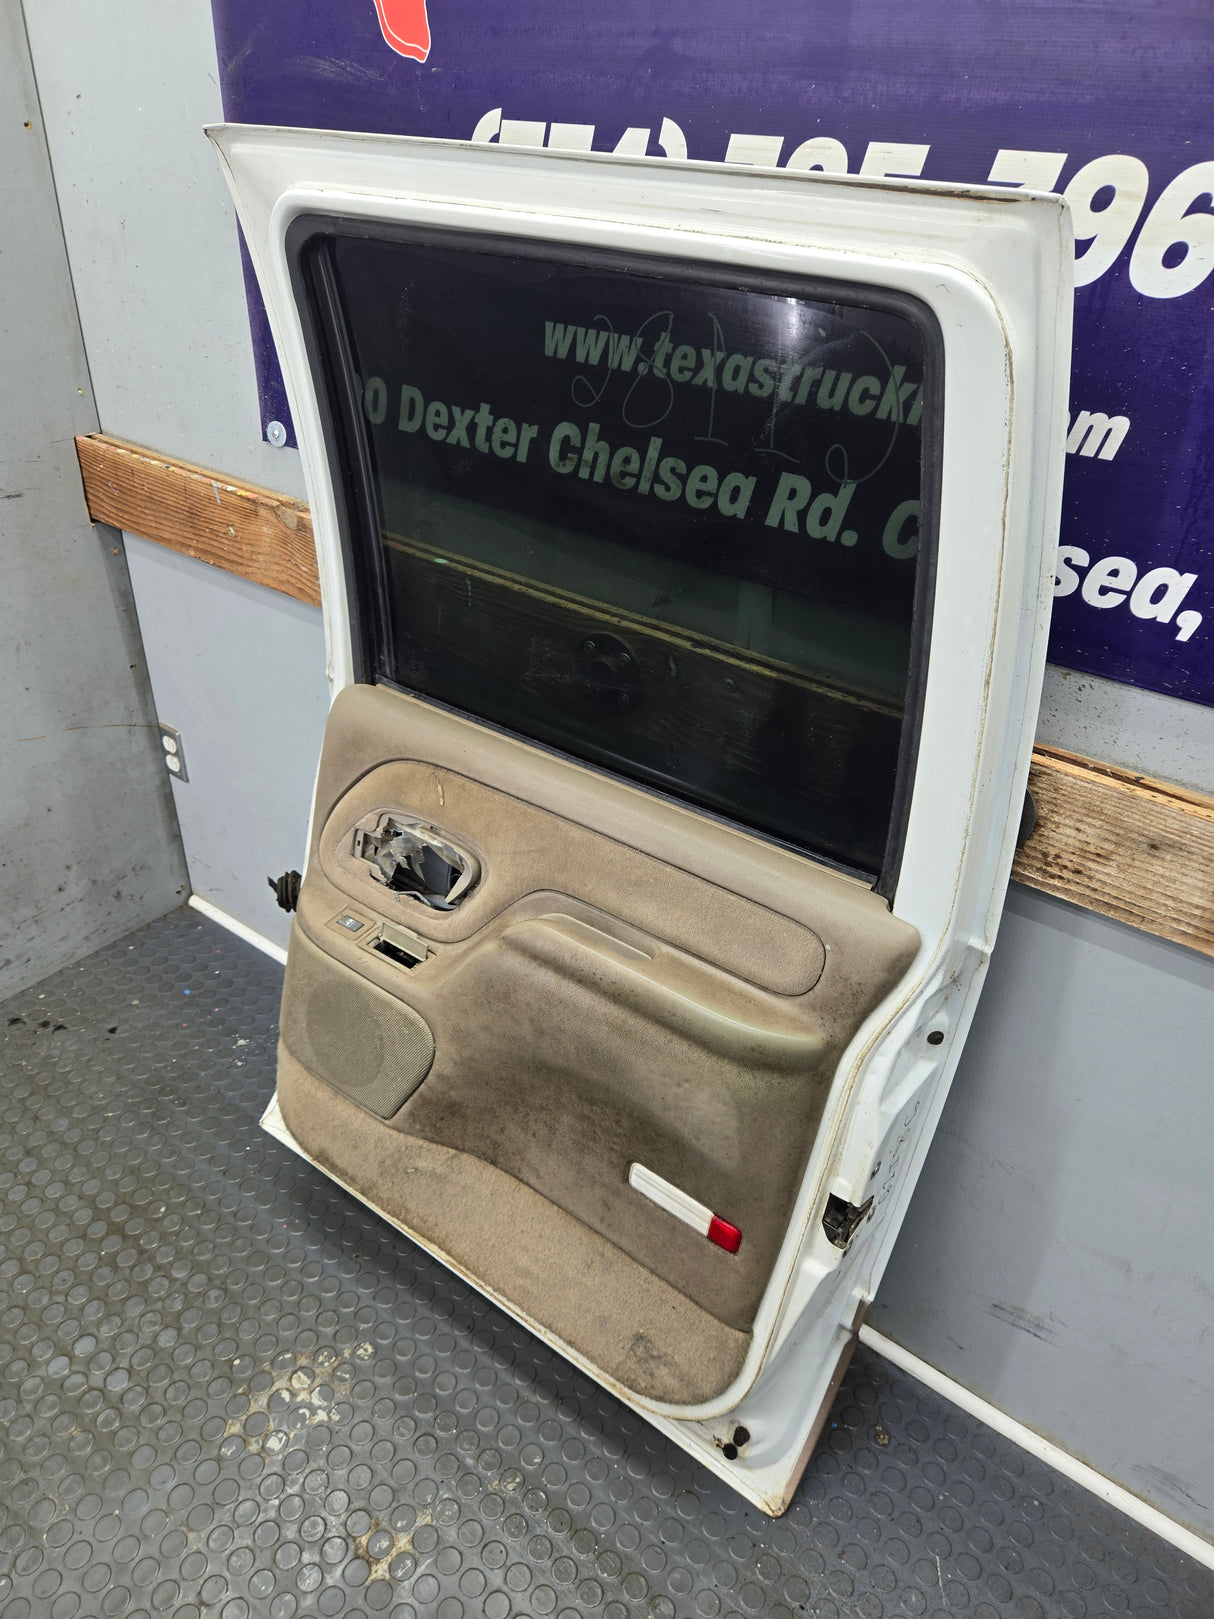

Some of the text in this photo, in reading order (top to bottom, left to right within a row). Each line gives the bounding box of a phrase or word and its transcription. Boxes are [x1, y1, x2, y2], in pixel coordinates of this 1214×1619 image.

[398, 384, 539, 464] Dexter
[549, 421, 758, 520] Chelsea
[764, 471, 860, 547] Rd.
[882, 499, 922, 560] C
[1053, 545, 1203, 642] sea,
